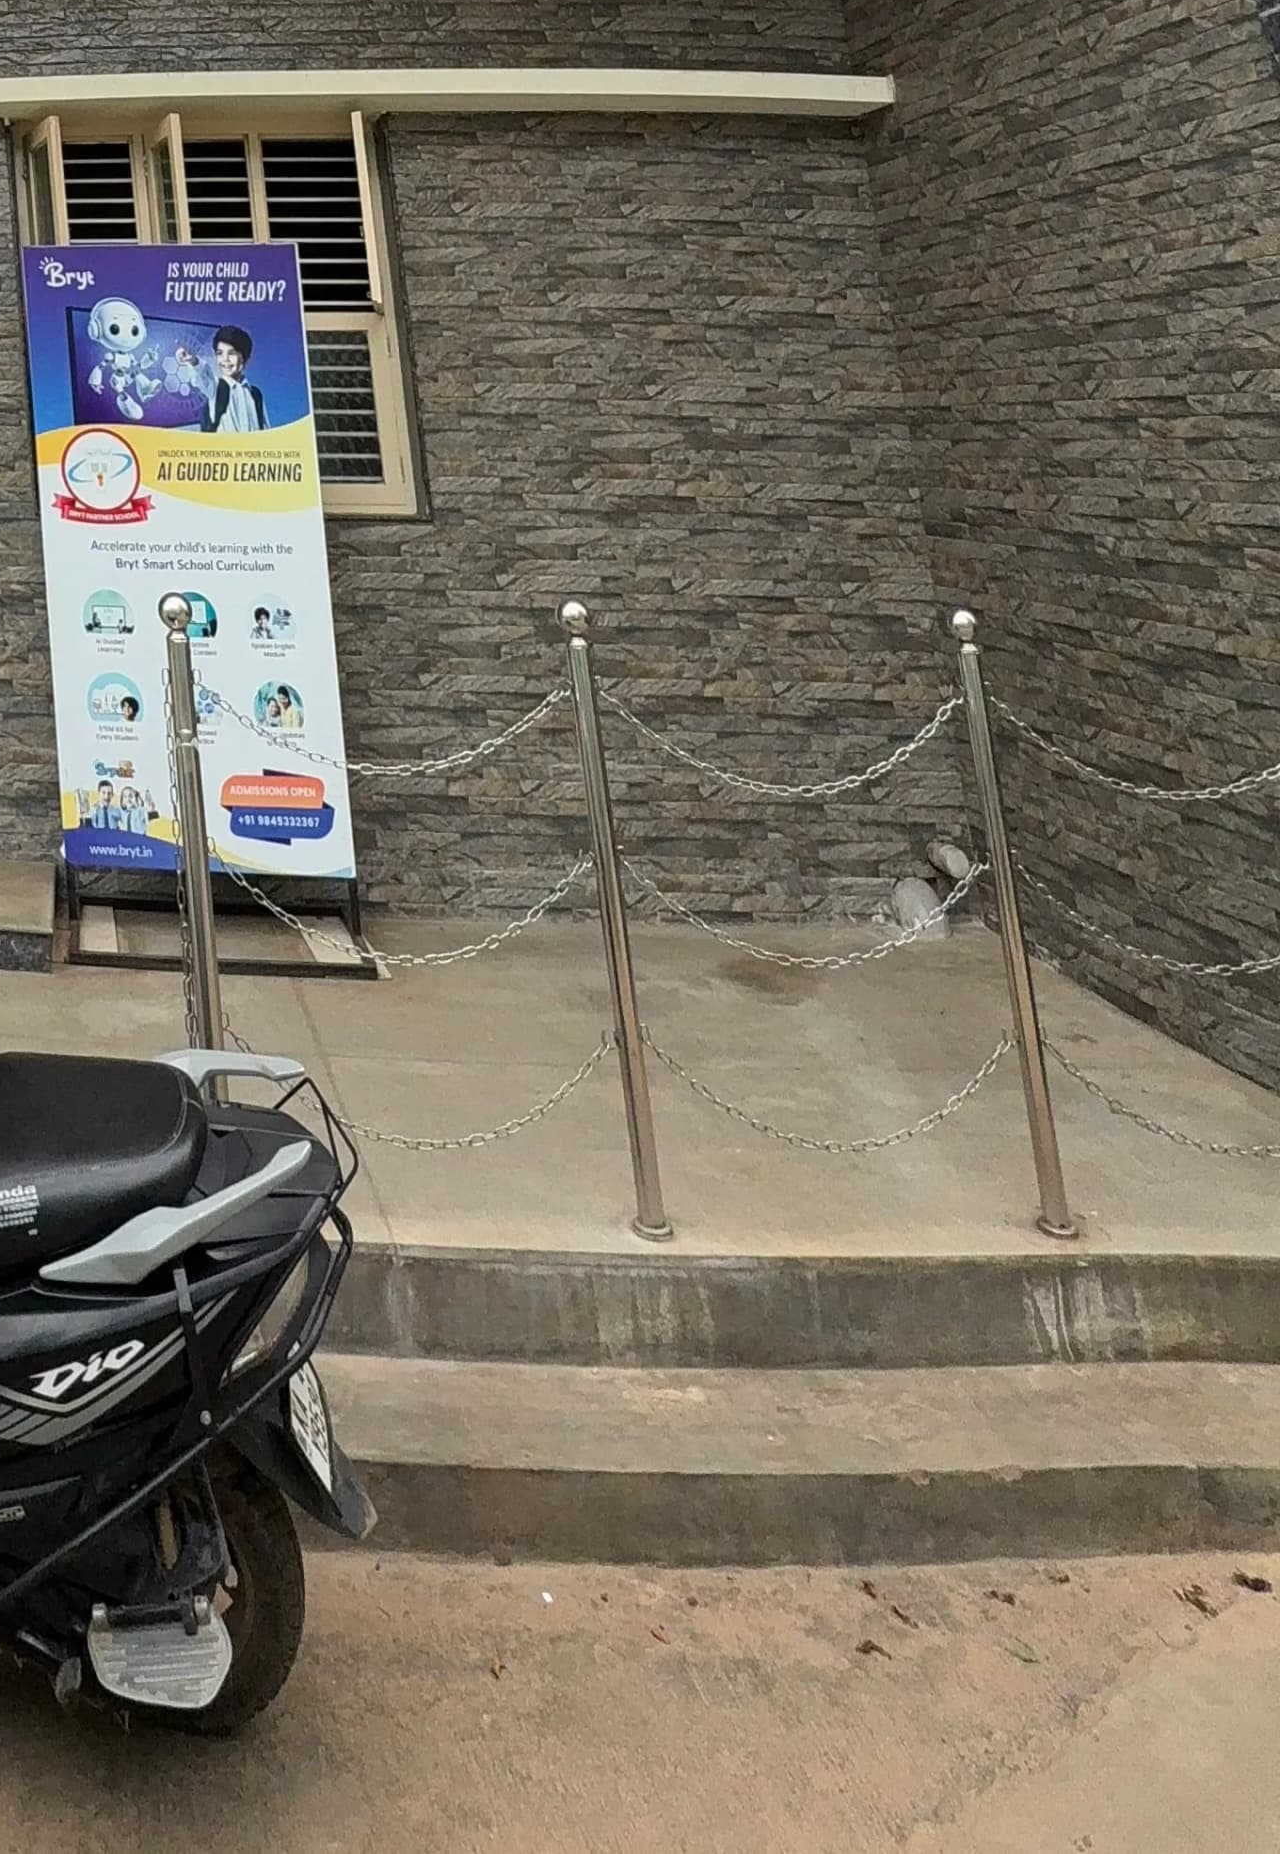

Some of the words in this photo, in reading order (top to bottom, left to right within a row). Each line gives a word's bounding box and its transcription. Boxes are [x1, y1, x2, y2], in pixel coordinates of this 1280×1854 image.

[44, 261, 96, 291] Bryt
[167, 262, 180, 278] IS
[182, 262, 214, 279] YOUR
[216, 262, 249, 278] CHILD
[165, 281, 223, 303] FUTURE
[227, 279, 287, 303] READY?
[157, 462, 172, 482] AI
[176, 462, 229, 482] GUIDED
[233, 462, 303, 483] LEARNING
[90, 540, 146, 552] Accelerate
[148, 543, 172, 554] your
[174, 541, 207, 554] child's
[208, 542, 249, 556] learning
[250, 543, 274, 555] with
[276, 543, 294, 555] the
[115, 558, 140, 571] Bryt
[142, 558, 175, 571] Smart
[177, 558, 214, 572] School
[216, 559, 275, 573] Curriculum
[230, 785, 289, 797] ADMISSIONS
[290, 786, 317, 798] OPEN
[89, 843, 153, 859] www.bryt.in
